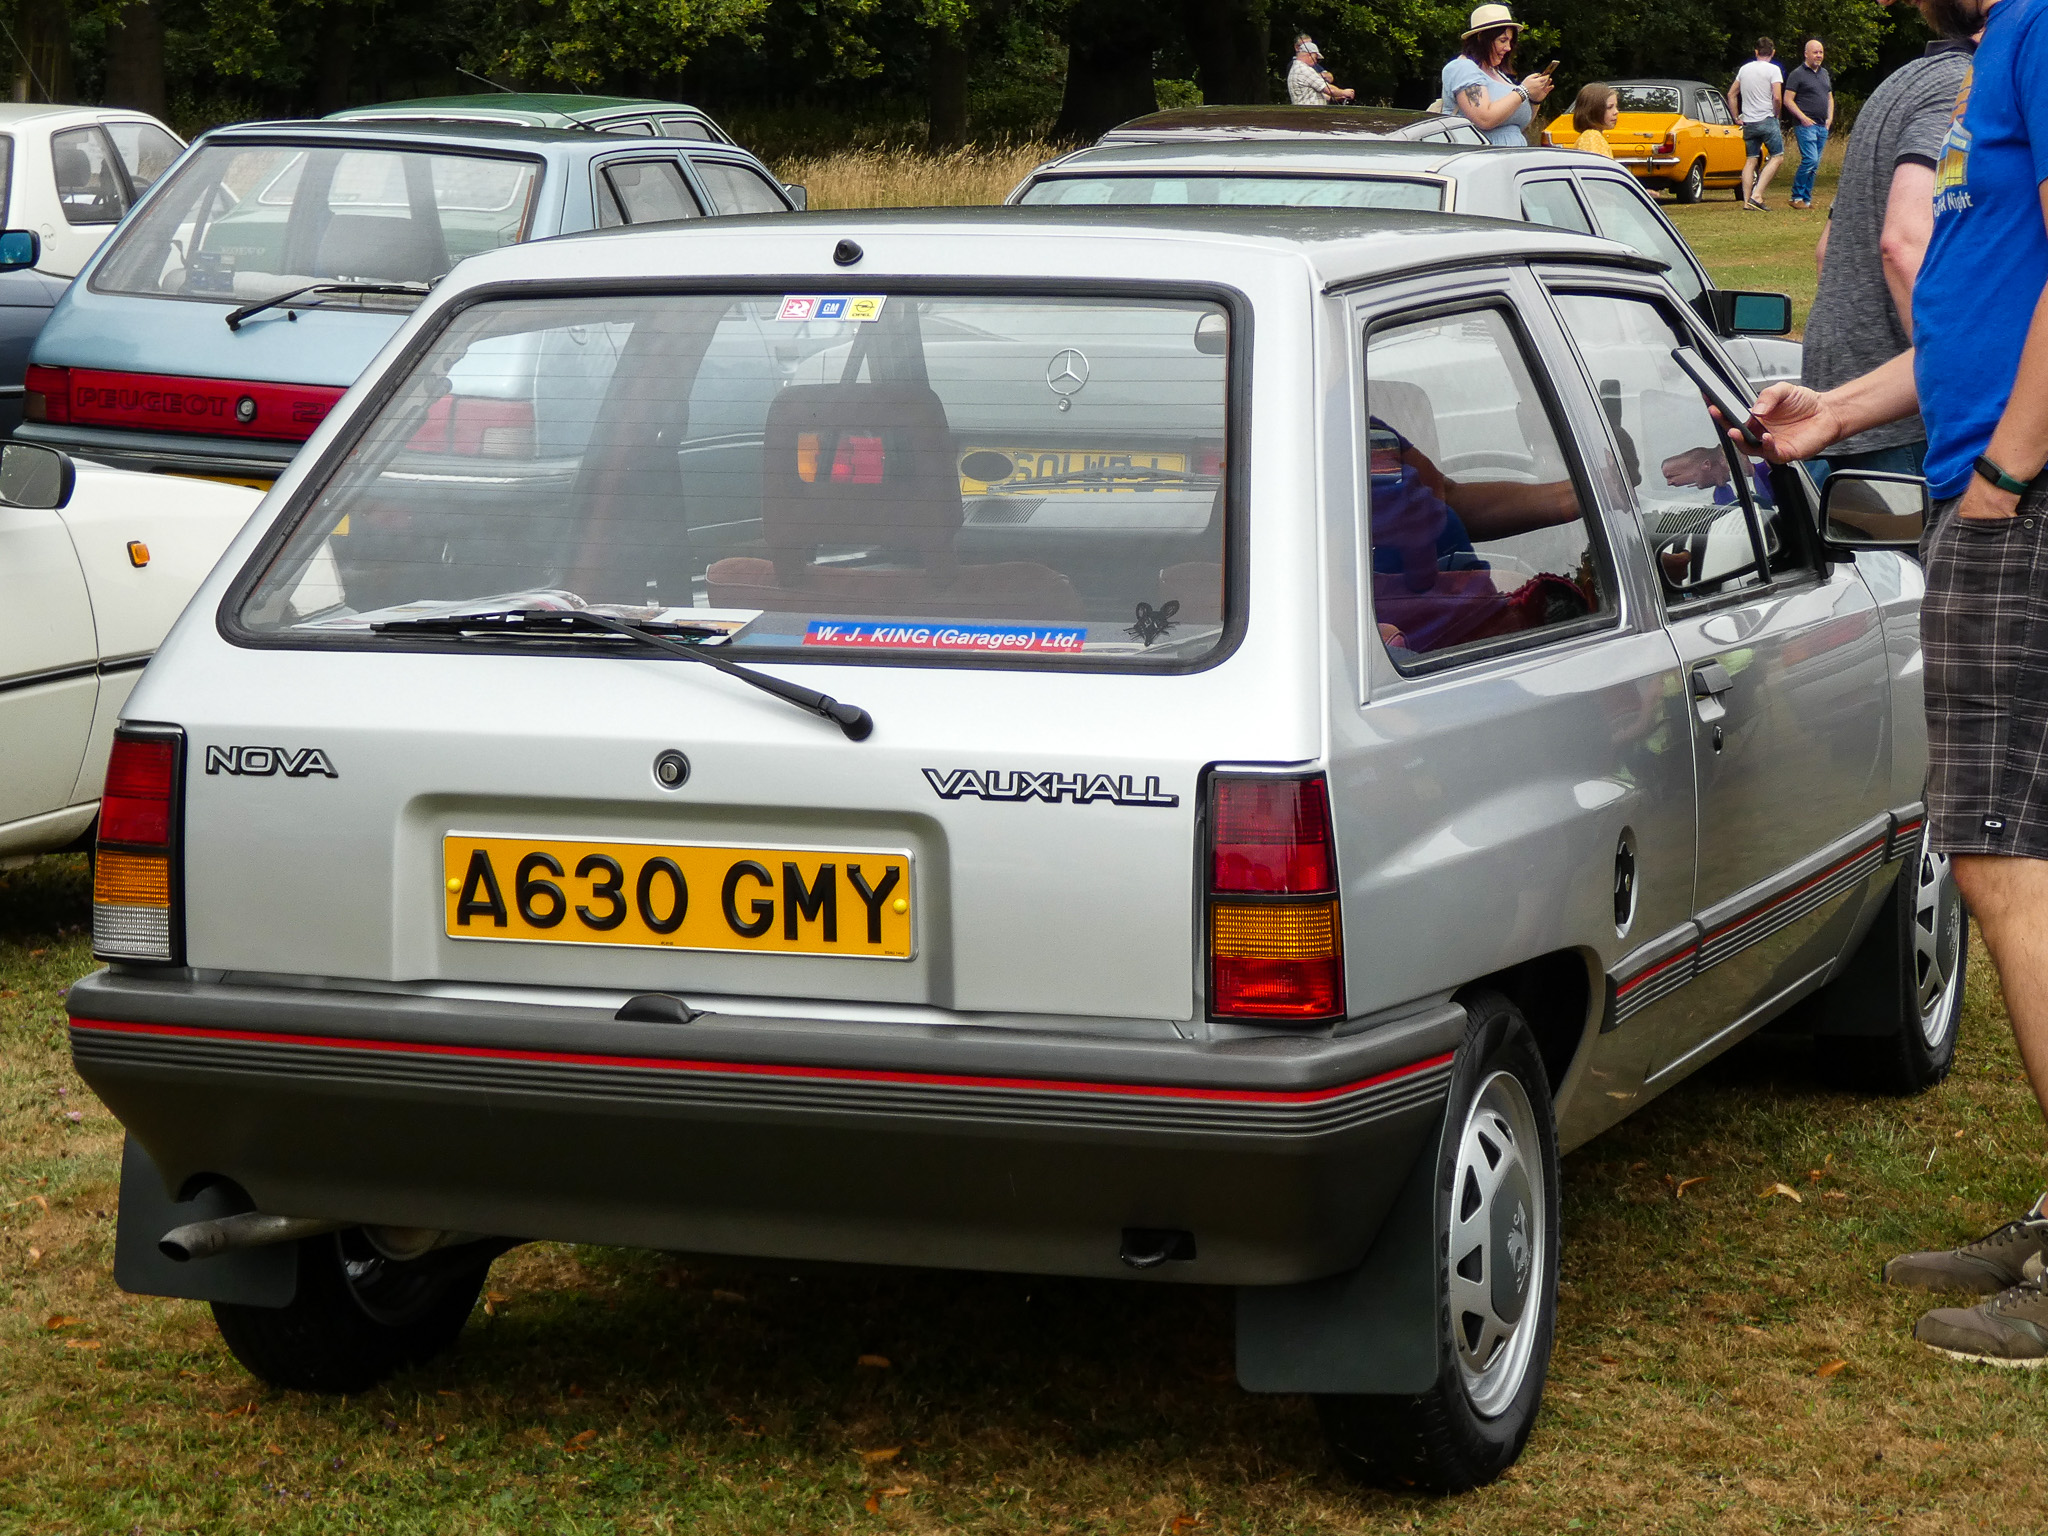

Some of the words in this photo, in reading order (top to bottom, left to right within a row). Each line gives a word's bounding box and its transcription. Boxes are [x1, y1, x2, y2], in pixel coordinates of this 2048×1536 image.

[1947, 190, 1974, 213] Night
[822, 303, 840, 312] GM
[77, 386, 228, 417] PEUGEOT
[816, 625, 838, 641] W.
[844, 627, 863, 643] J.
[870, 627, 930, 644] KING
[932, 628, 1036, 650] (Garages)
[1041, 630, 1080, 648] Ltd.
[205, 745, 339, 778] NOVA
[921, 768, 1180, 807] VAUXHALL
[456, 849, 689, 935] A630
[720, 859, 900, 944] GMY
